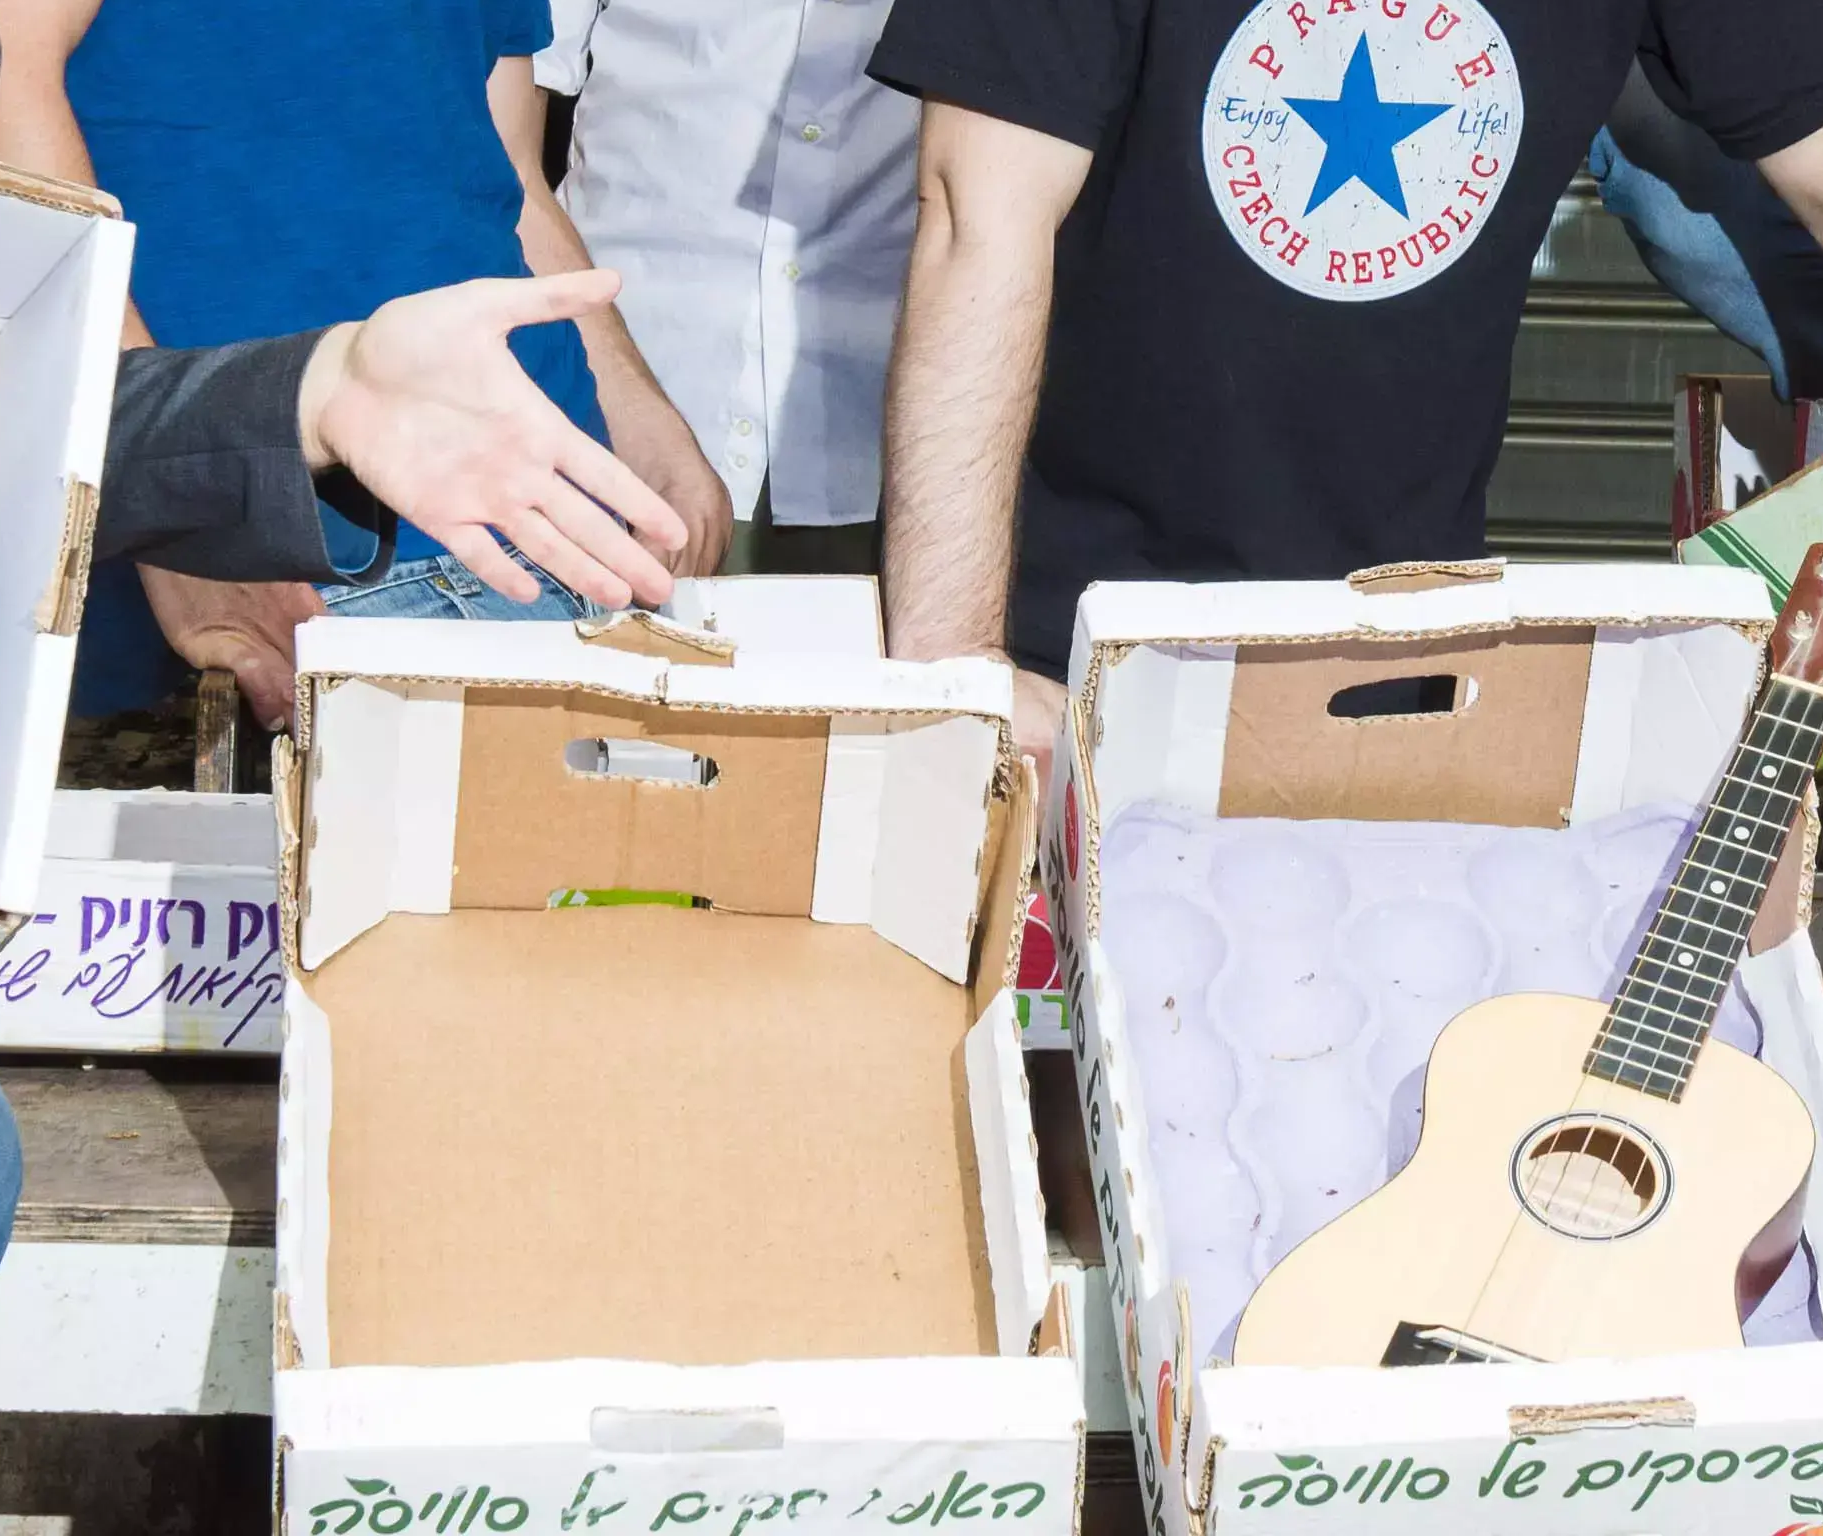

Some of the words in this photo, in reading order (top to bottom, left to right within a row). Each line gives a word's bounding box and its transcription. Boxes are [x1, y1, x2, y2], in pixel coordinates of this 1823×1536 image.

[1220, 96, 1290, 142] Enjoy
[1458, 102, 1508, 150] Life!
[1222, 144, 1309, 267] CZECH
[1325, 155, 1499, 284] REPUBLIC
[80, 895, 205, 955] רזניק
[122, 948, 282, 1047] קלאות
[1239, 1457, 1450, 1508] סוויסה
[1478, 1436, 1546, 1498] של
[309, 1485, 530, 1536] סוויסה
